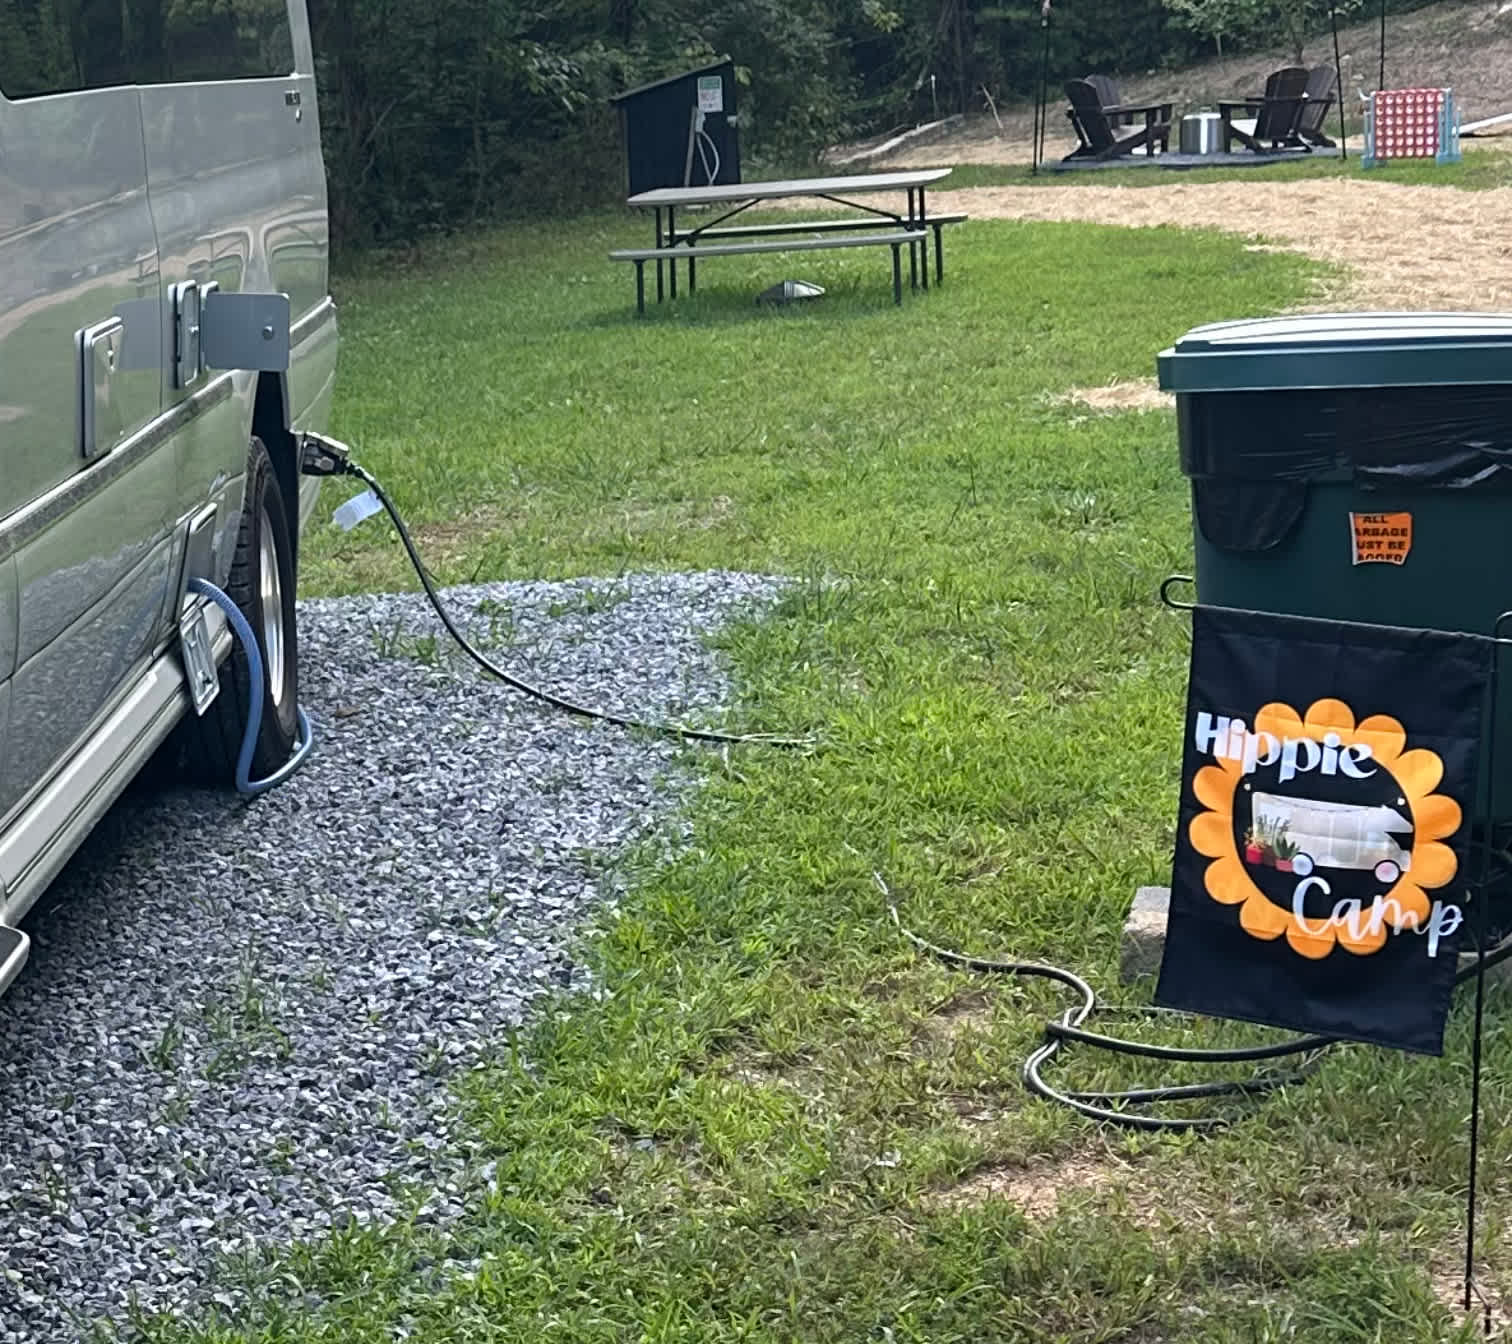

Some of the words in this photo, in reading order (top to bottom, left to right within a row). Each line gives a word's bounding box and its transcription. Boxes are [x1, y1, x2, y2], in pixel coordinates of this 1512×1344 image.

[1362, 515, 1389, 524] ALL
[1354, 527, 1409, 537] ARBAGE
[1355, 541, 1384, 550] UST
[1388, 541, 1406, 551] BE
[1195, 711, 1378, 784] Hippie
[1292, 876, 1464, 958] Camp
